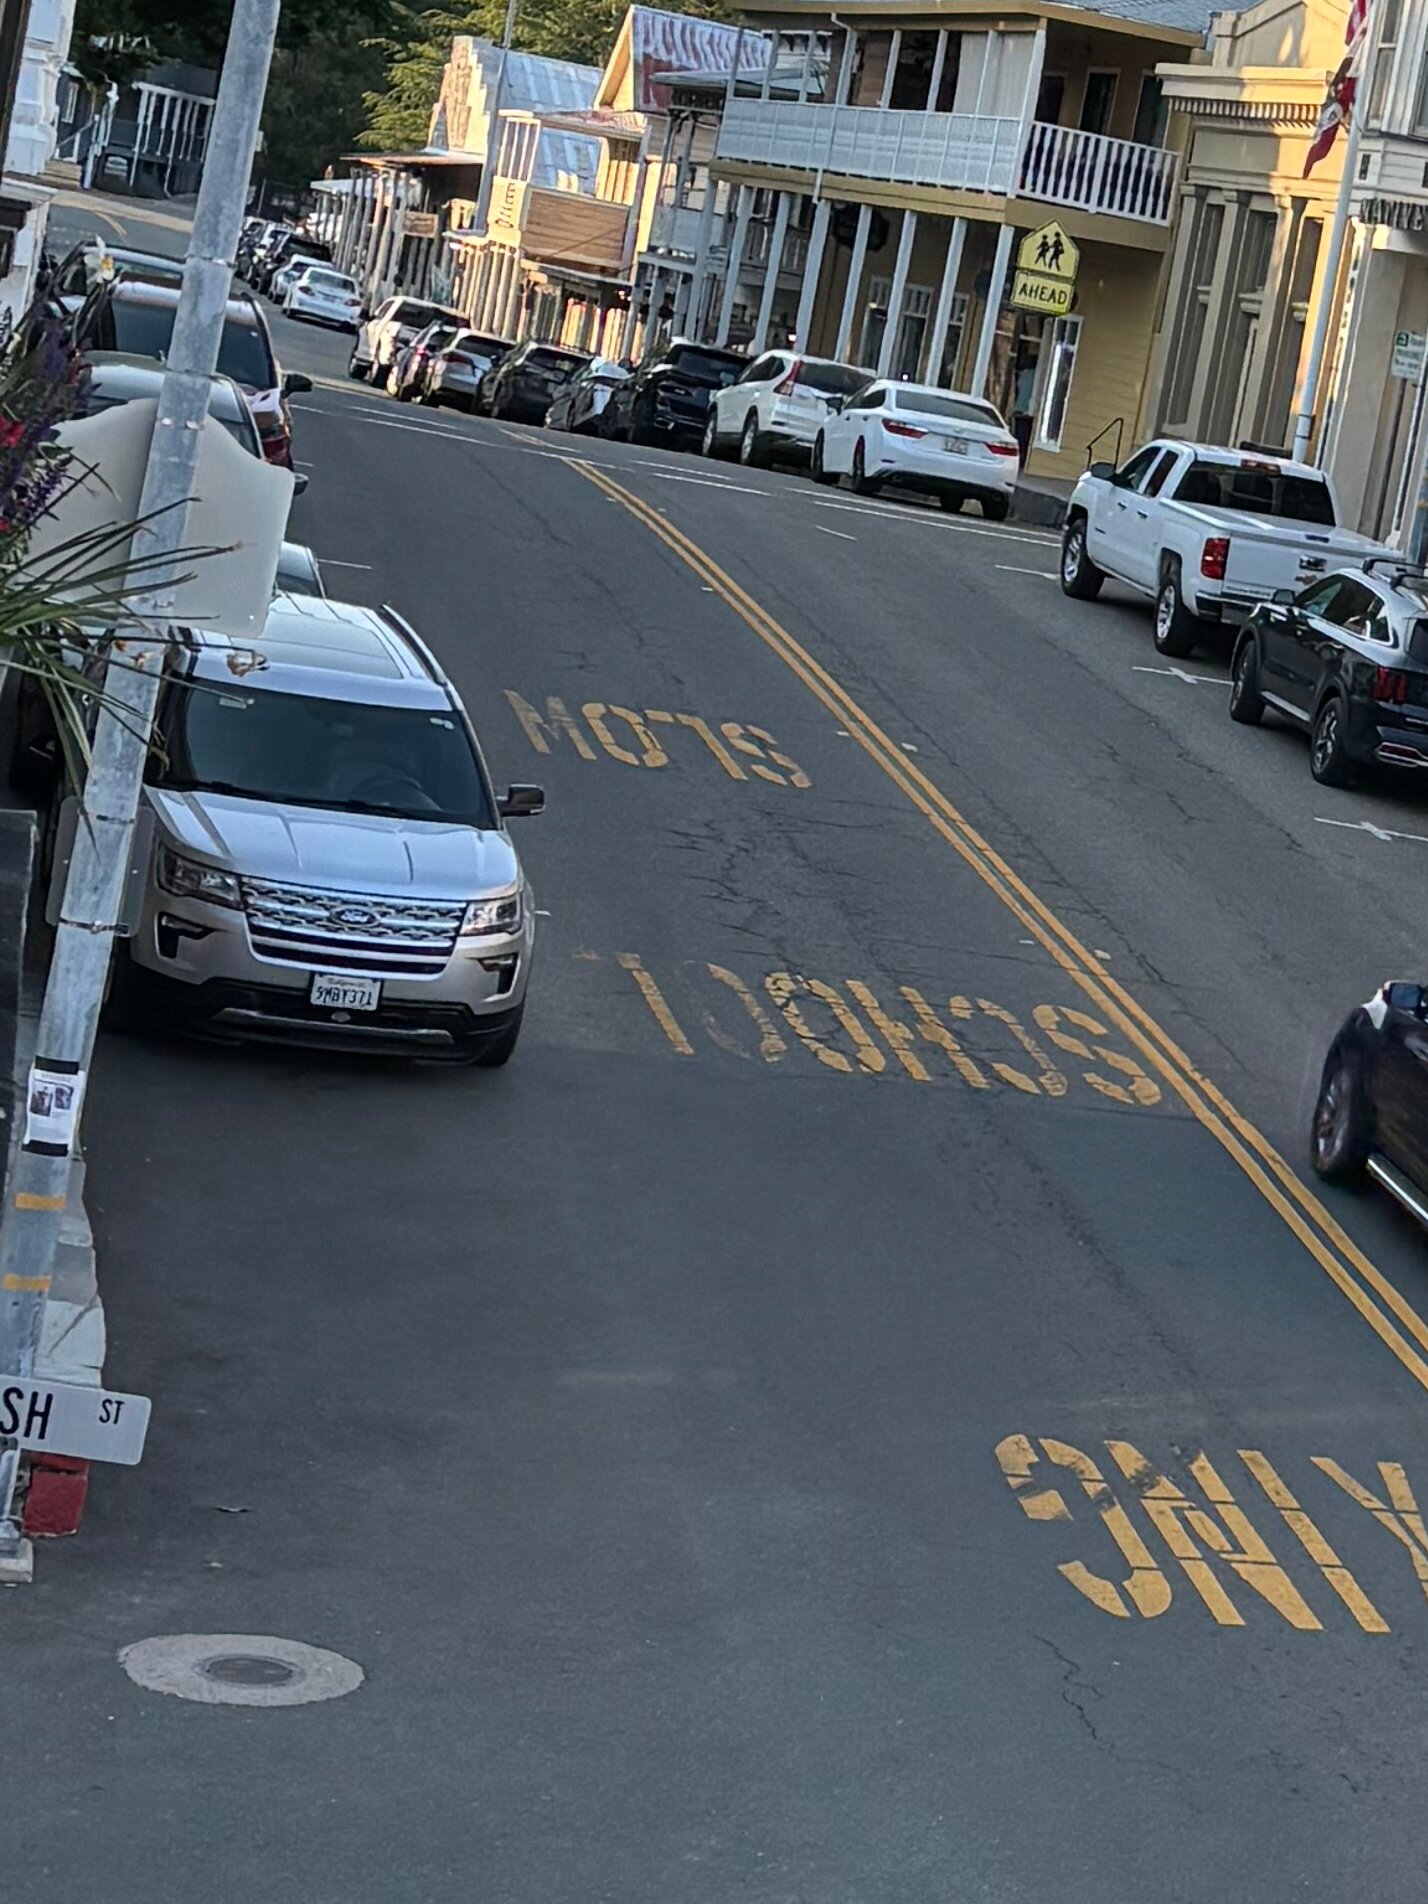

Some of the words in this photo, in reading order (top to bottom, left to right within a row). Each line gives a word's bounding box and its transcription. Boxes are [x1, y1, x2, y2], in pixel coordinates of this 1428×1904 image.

[1018, 281, 1068, 305] AHEAD
[503, 689, 812, 788] SLOW
[98, 1398, 126, 1427] ST
